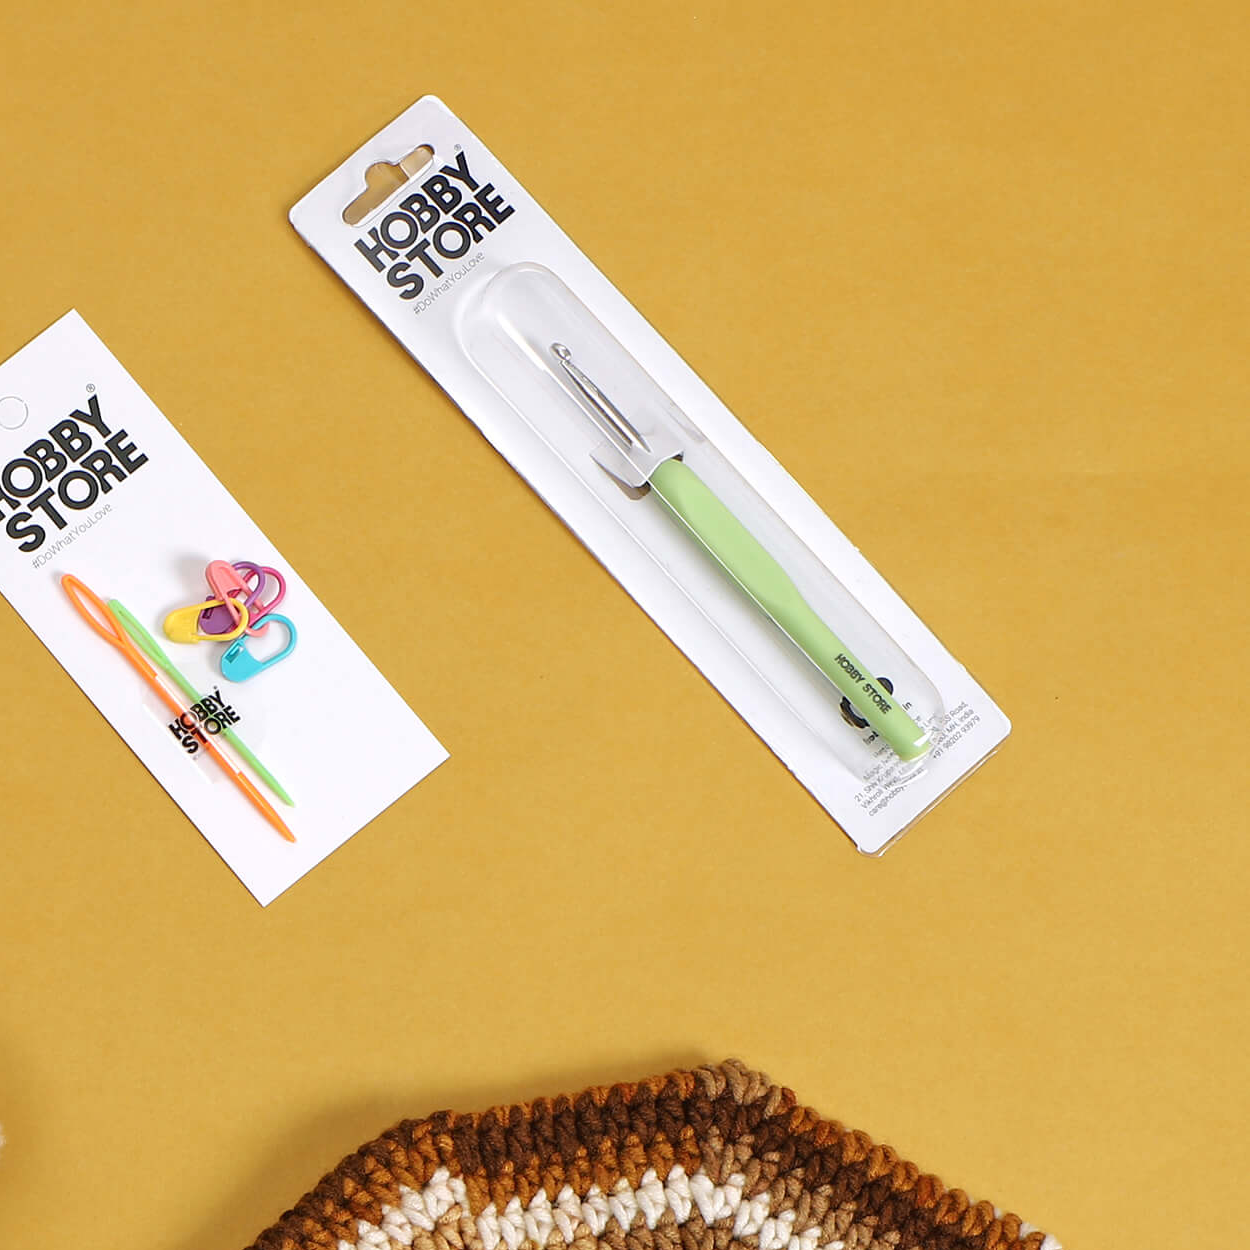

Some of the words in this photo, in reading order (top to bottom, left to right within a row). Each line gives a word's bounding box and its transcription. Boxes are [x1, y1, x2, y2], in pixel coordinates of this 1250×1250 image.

[354, 151, 480, 273] HOBBY
[387, 183, 516, 300] STORE
[413, 252, 485, 314] #DoWhatYouLove
[6, 429, 149, 552] STORE
[31, 503, 112, 569] #DoWhatYouLove
[168, 690, 225, 740] HOBBY
[834, 653, 865, 683] HOBBY
[862, 683, 892, 715] STORE
[182, 705, 241, 753] STORE
